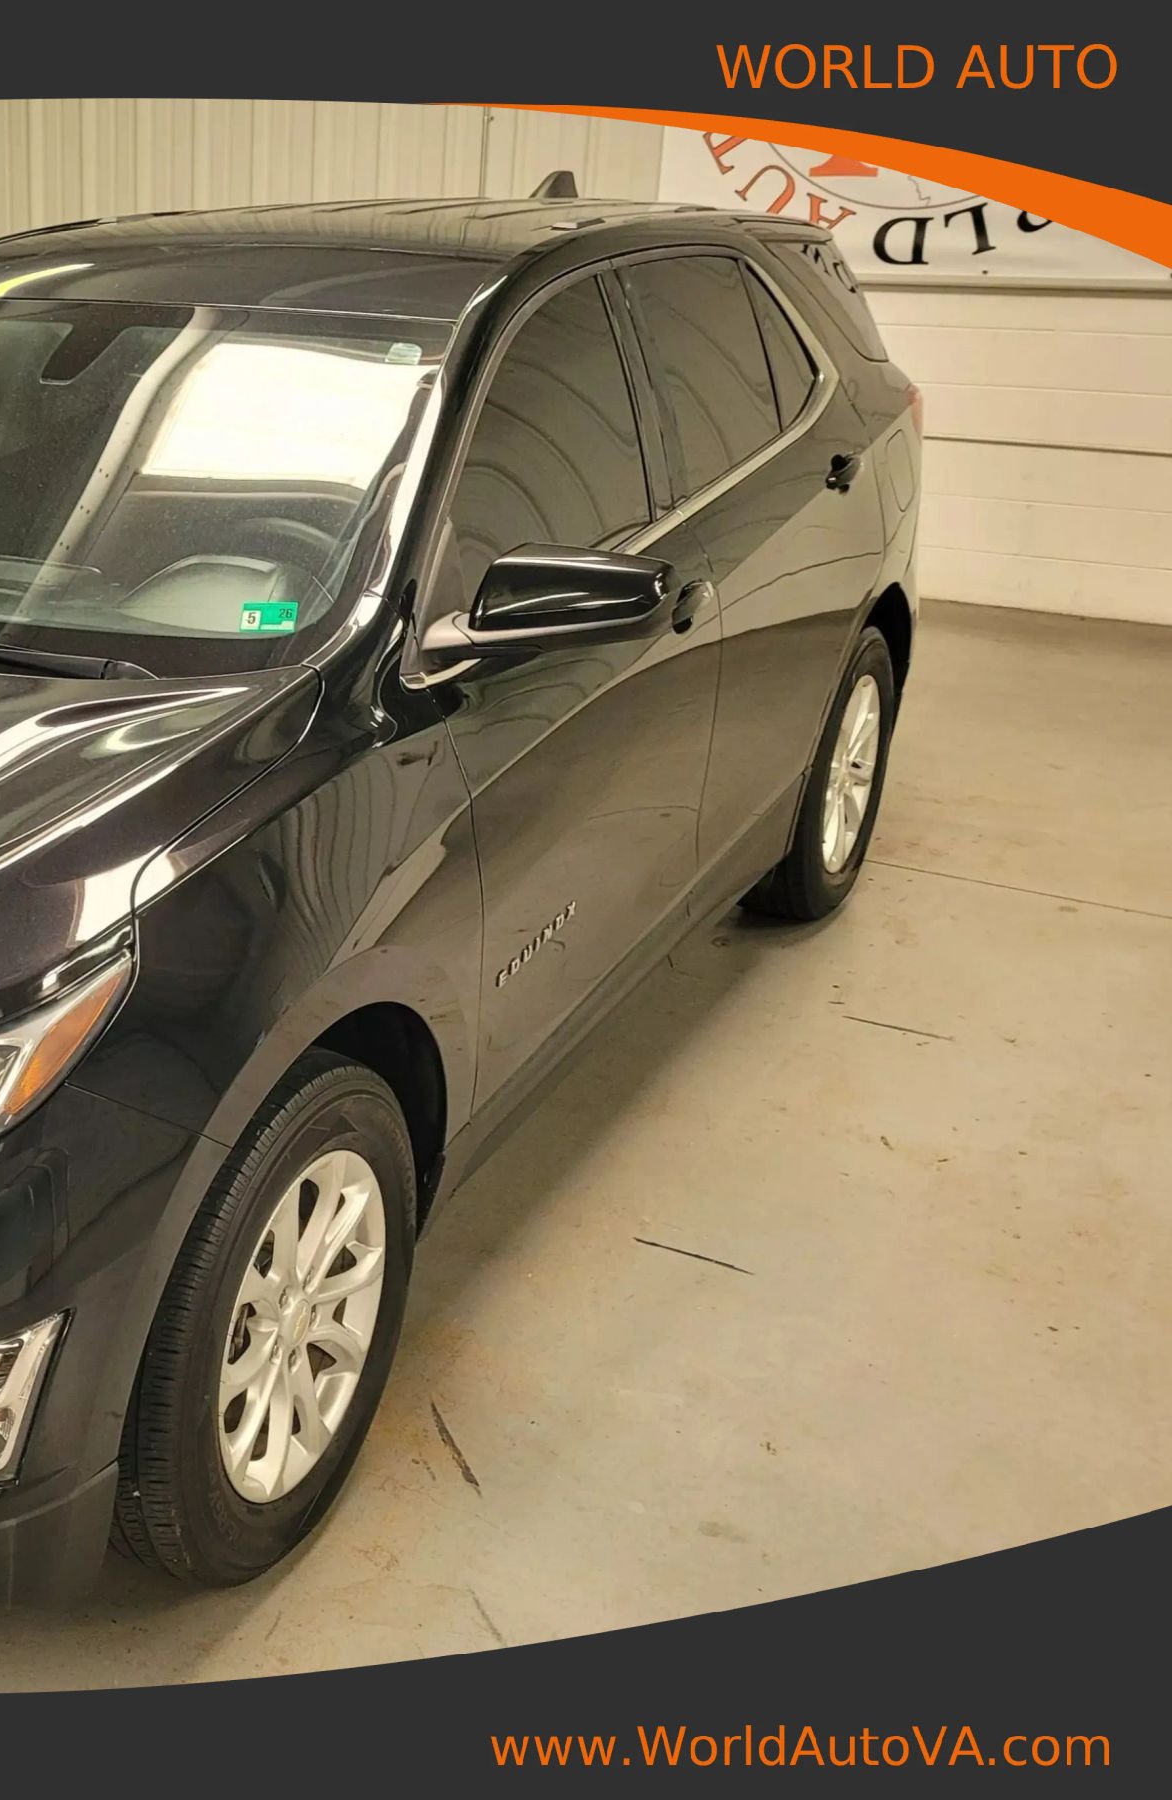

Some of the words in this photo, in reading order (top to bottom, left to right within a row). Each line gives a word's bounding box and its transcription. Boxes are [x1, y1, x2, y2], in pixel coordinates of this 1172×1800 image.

[246, 611, 257, 625] 5
[278, 608, 293, 619] 26
[495, 901, 576, 988] EQUINOX
